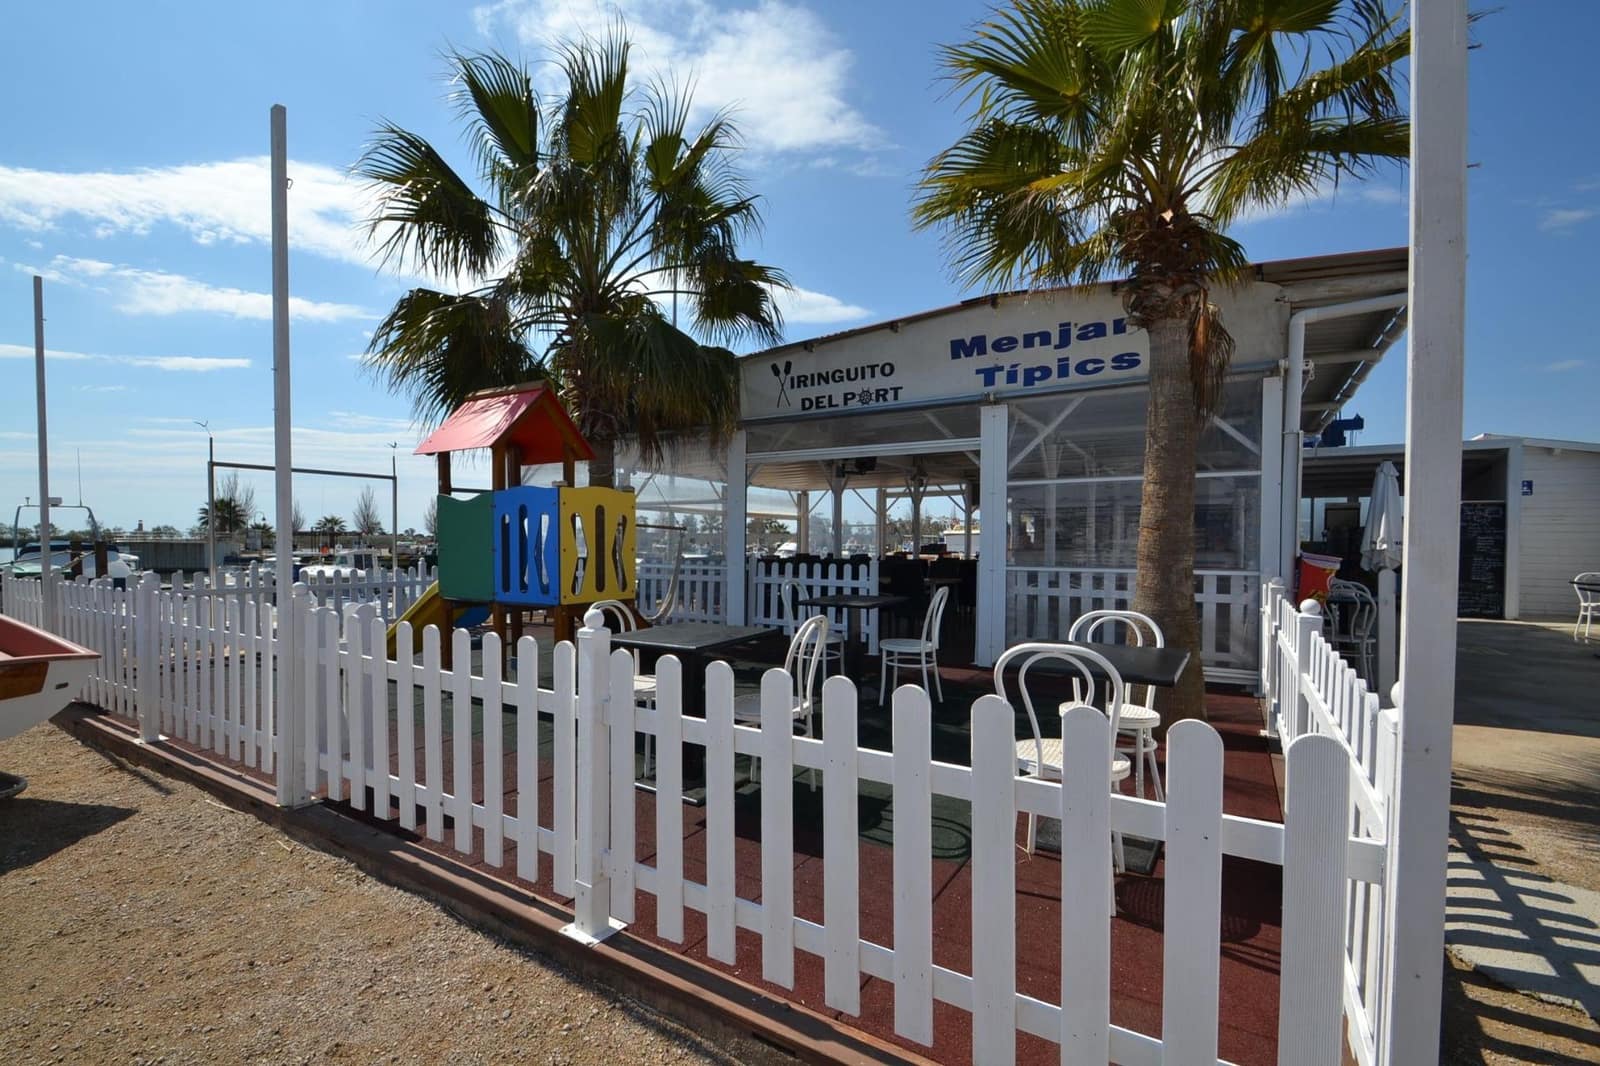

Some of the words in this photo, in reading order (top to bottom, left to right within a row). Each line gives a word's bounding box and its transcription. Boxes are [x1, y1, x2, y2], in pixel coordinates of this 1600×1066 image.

[950, 317, 1127, 360] Menjar
[975, 352, 1141, 388] Típics
[801, 394, 839, 411] DEL
